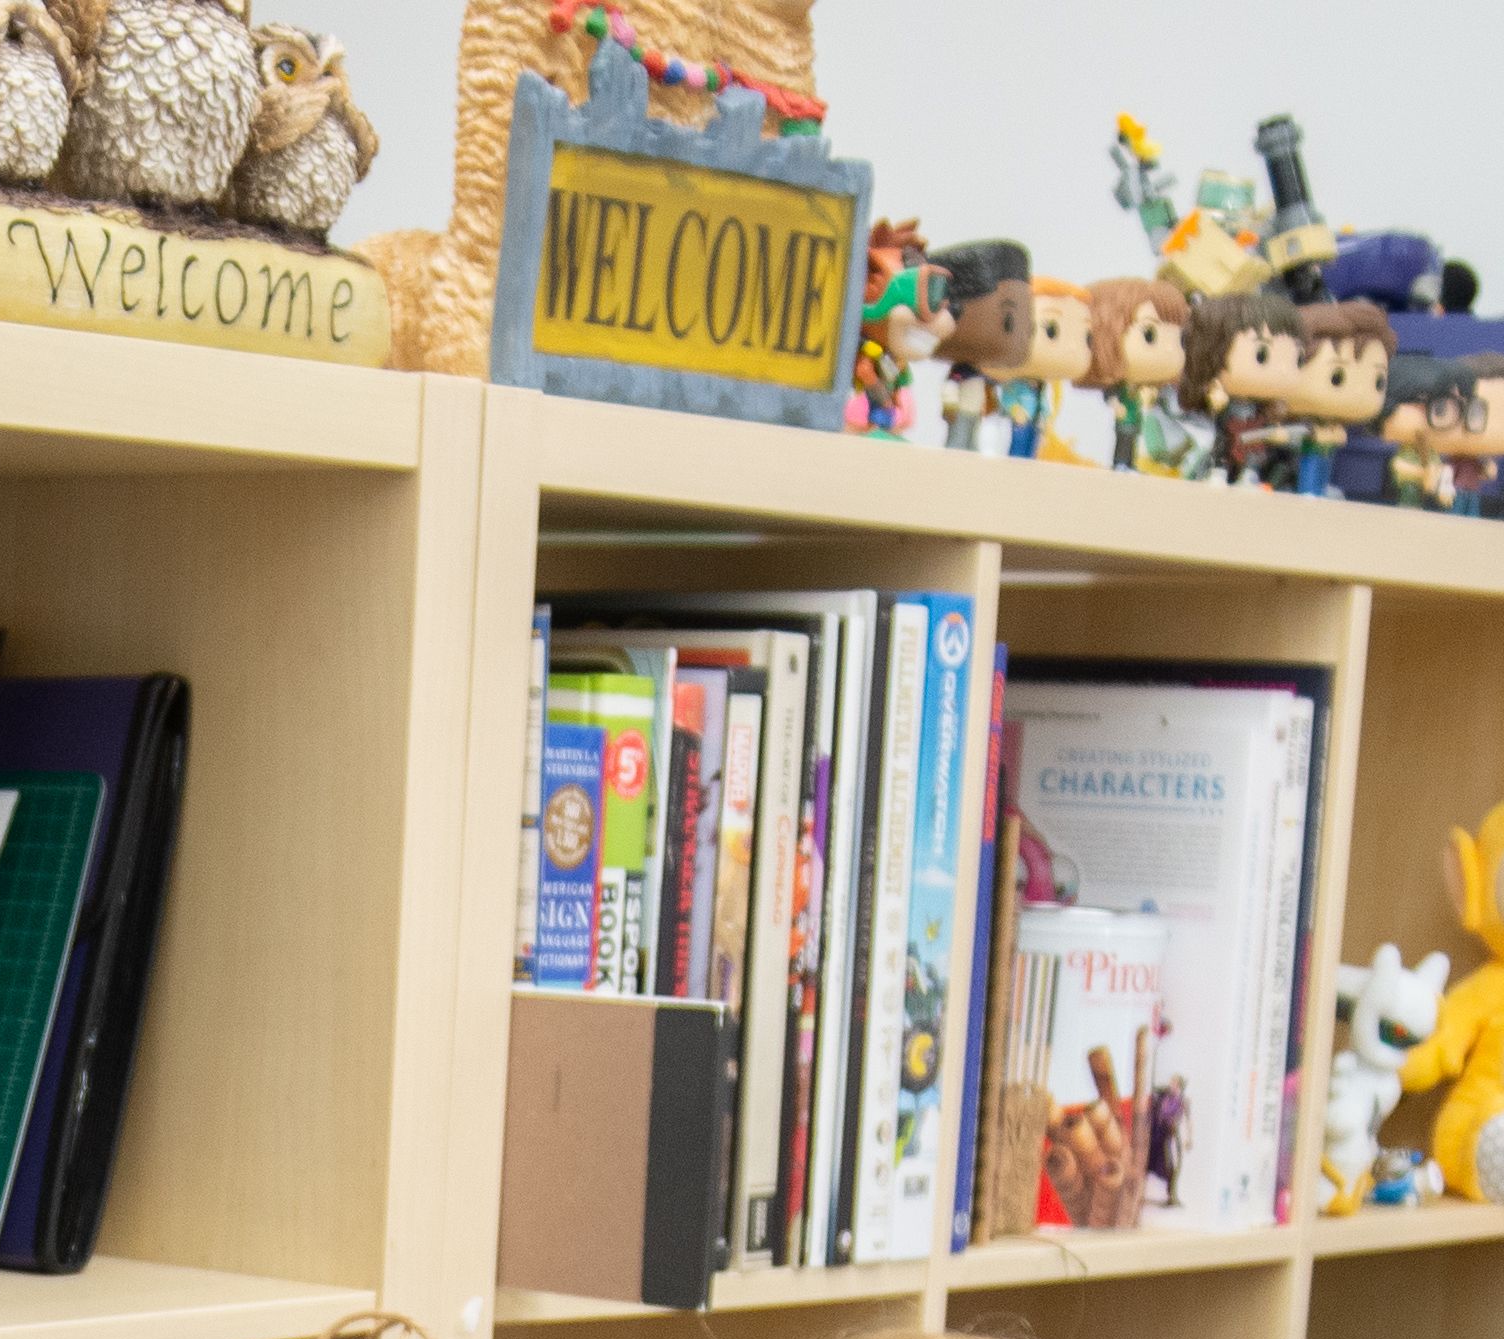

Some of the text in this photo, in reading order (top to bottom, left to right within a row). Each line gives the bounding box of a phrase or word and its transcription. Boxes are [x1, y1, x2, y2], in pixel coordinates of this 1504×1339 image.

[8, 217, 355, 345] Welcome
[545, 184, 840, 362] WELCOME
[933, 669, 957, 857] OVERWATCH
[1039, 766, 1226, 801] CHARACTERS
[597, 882, 620, 988] BOOK
